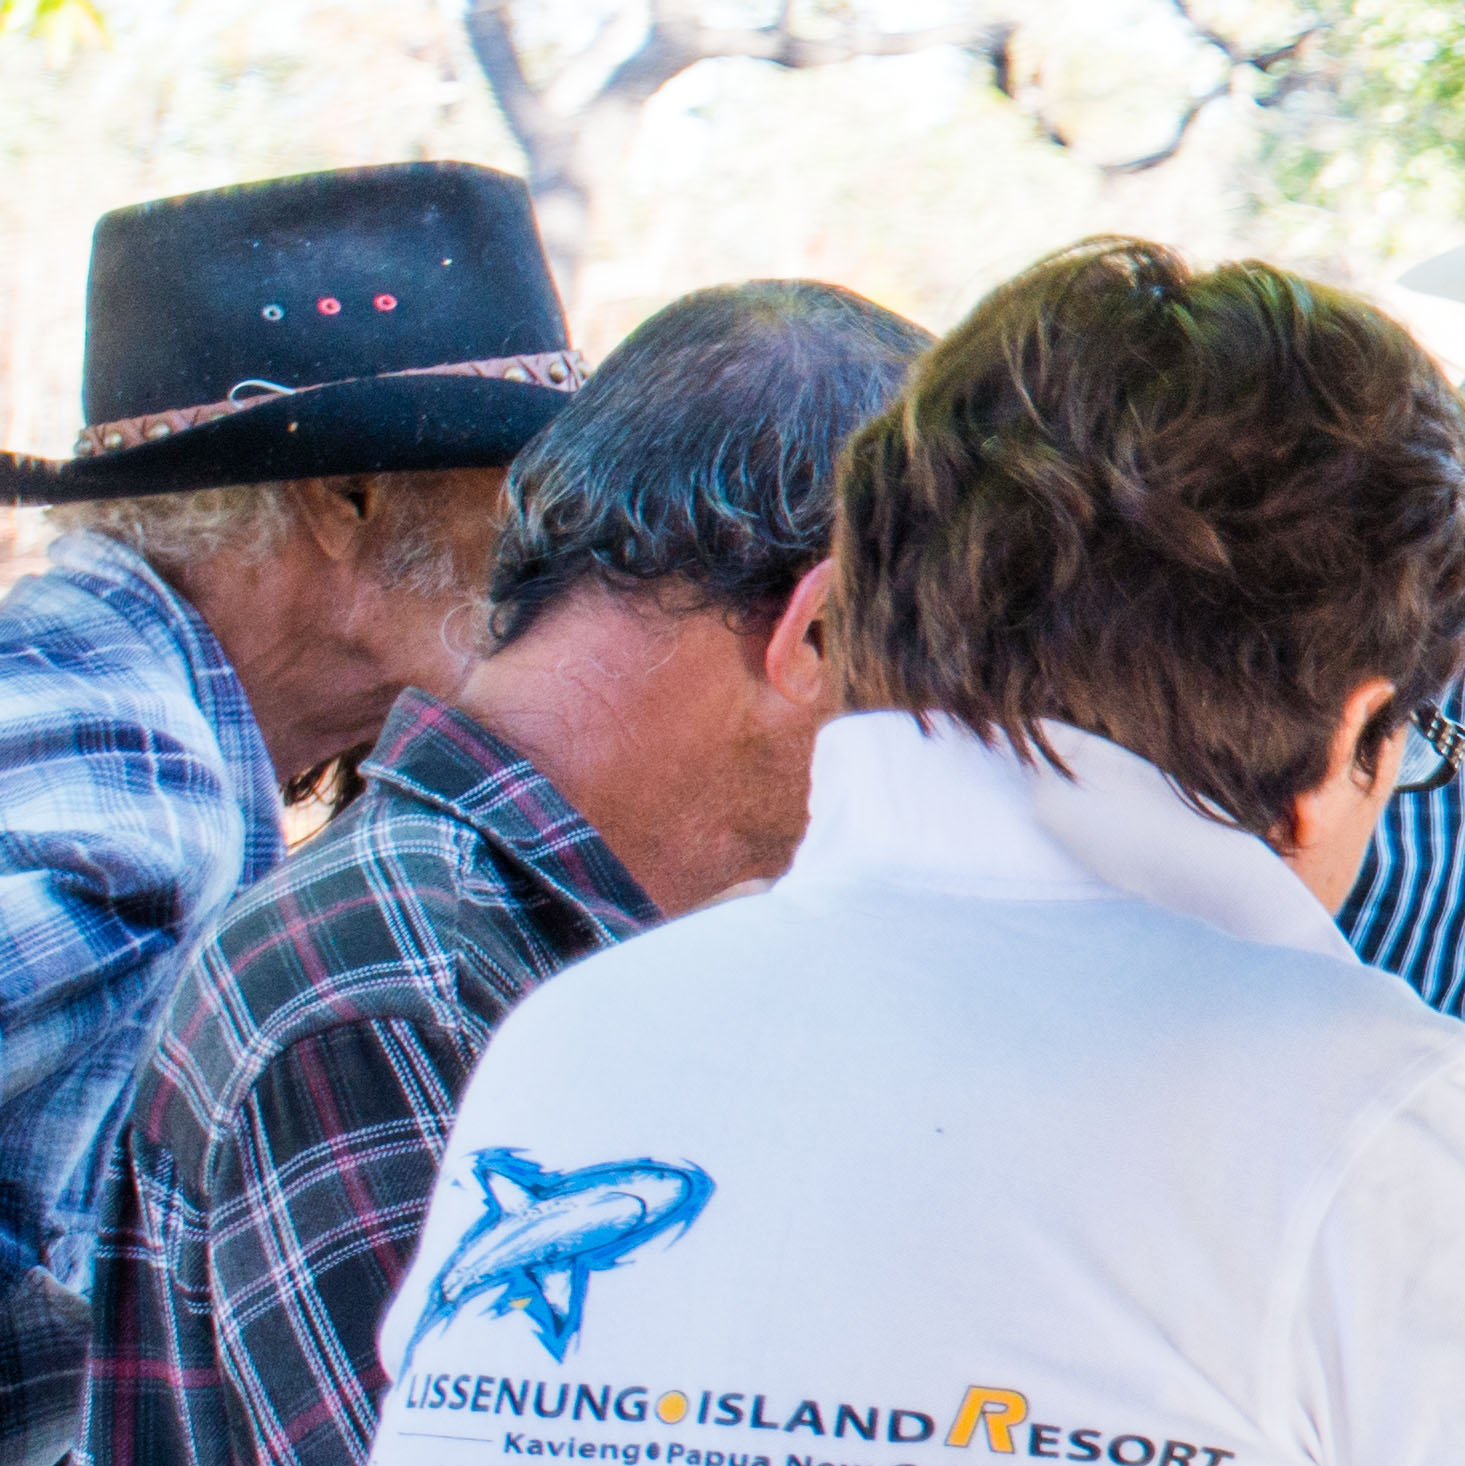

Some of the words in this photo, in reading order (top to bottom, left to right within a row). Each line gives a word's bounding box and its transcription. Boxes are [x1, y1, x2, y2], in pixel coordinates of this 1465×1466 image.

[405, 1373, 649, 1423] LISSENUNG
[696, 1389, 936, 1443] ISLAND
[503, 1431, 640, 1466] Kavieng
